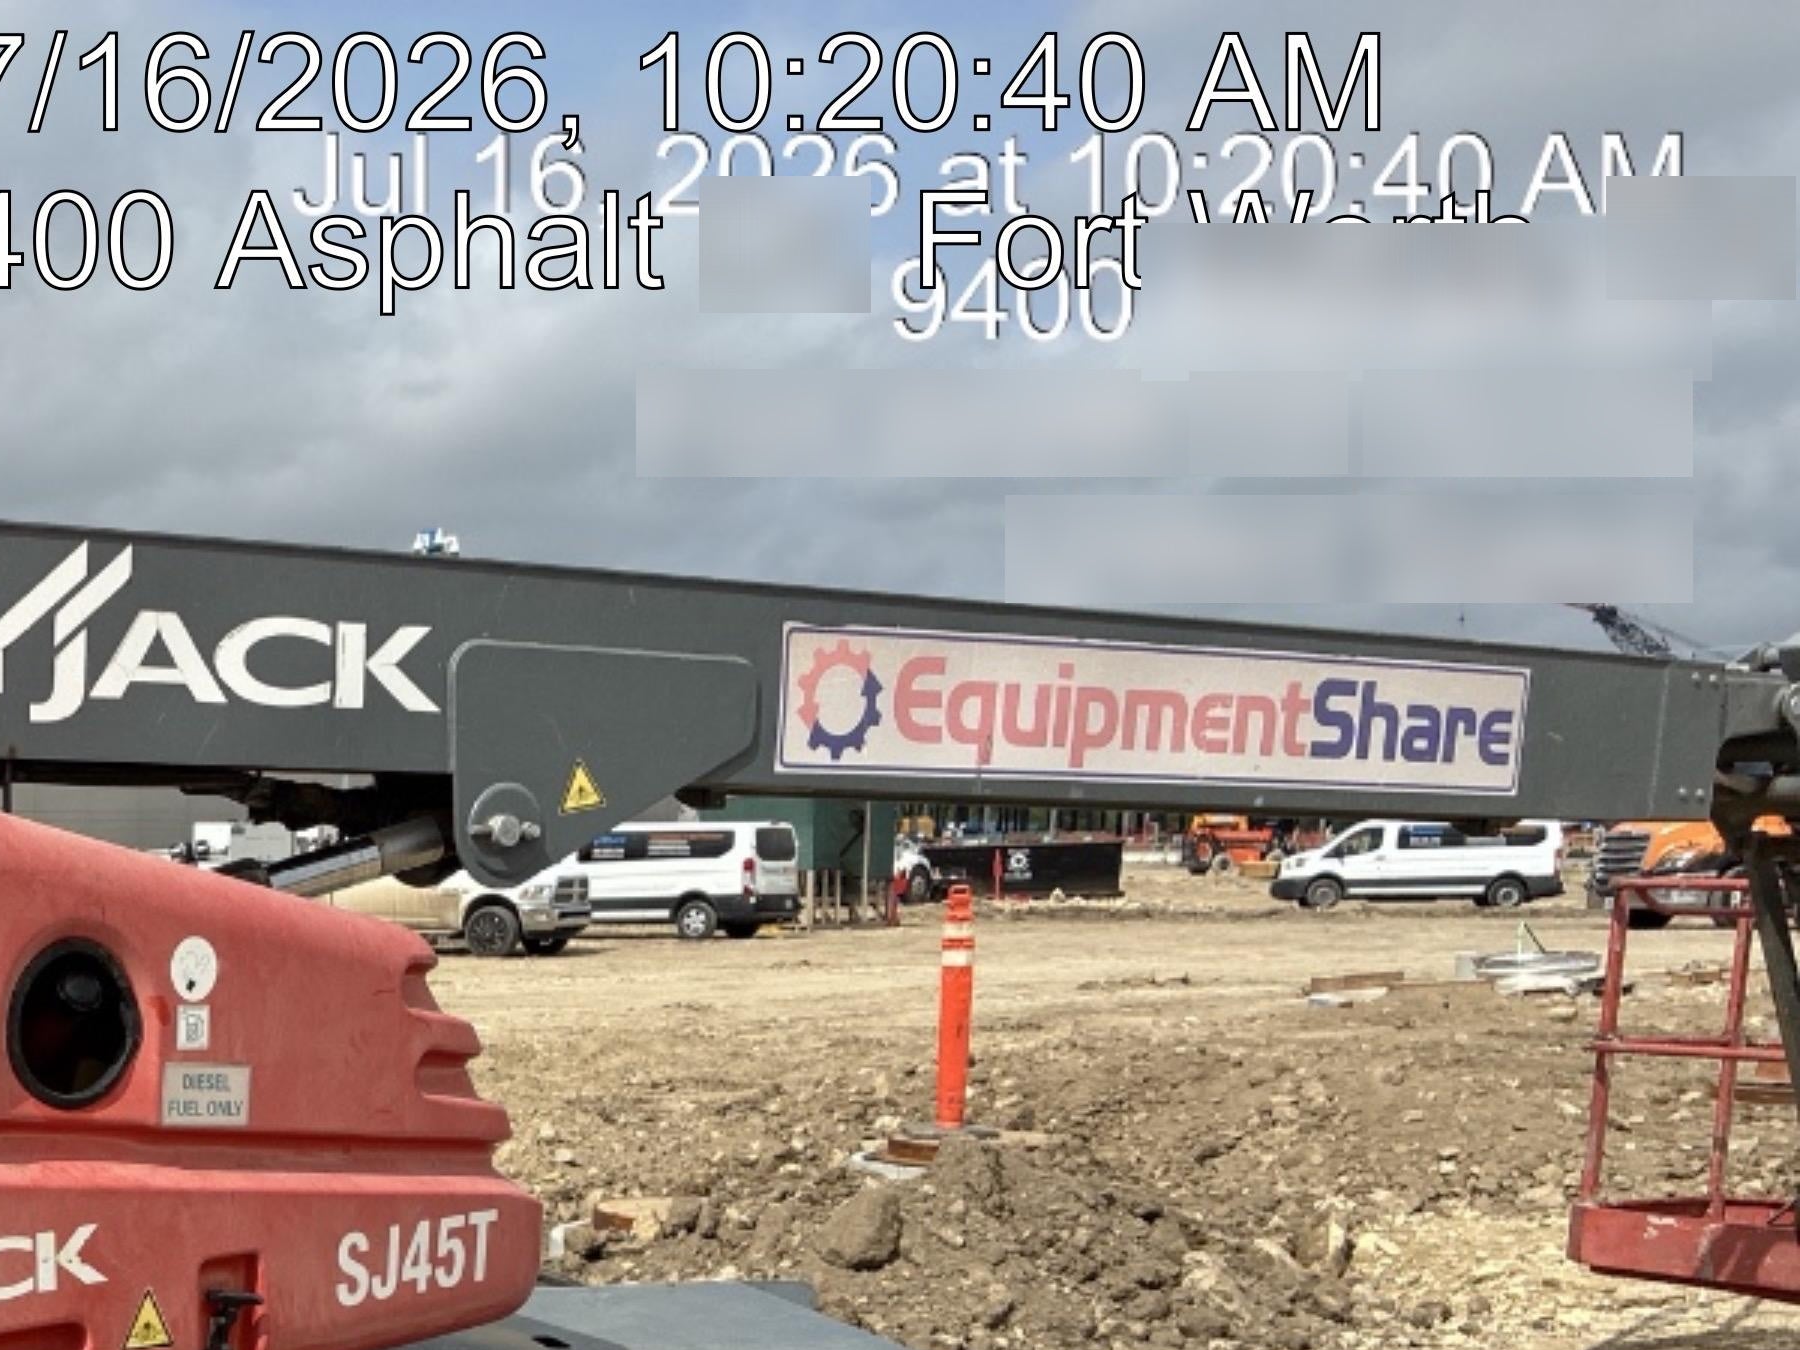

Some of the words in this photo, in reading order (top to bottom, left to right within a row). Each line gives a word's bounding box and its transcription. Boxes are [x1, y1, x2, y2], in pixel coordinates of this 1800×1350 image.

[892, 656, 1513, 767] EquipmentShare
[167, 1100, 203, 1117] FUEL
[206, 1100, 244, 1117] ONLY
[182, 1073, 231, 1092] DIESEL
[336, 1208, 499, 1306] SJ45T
